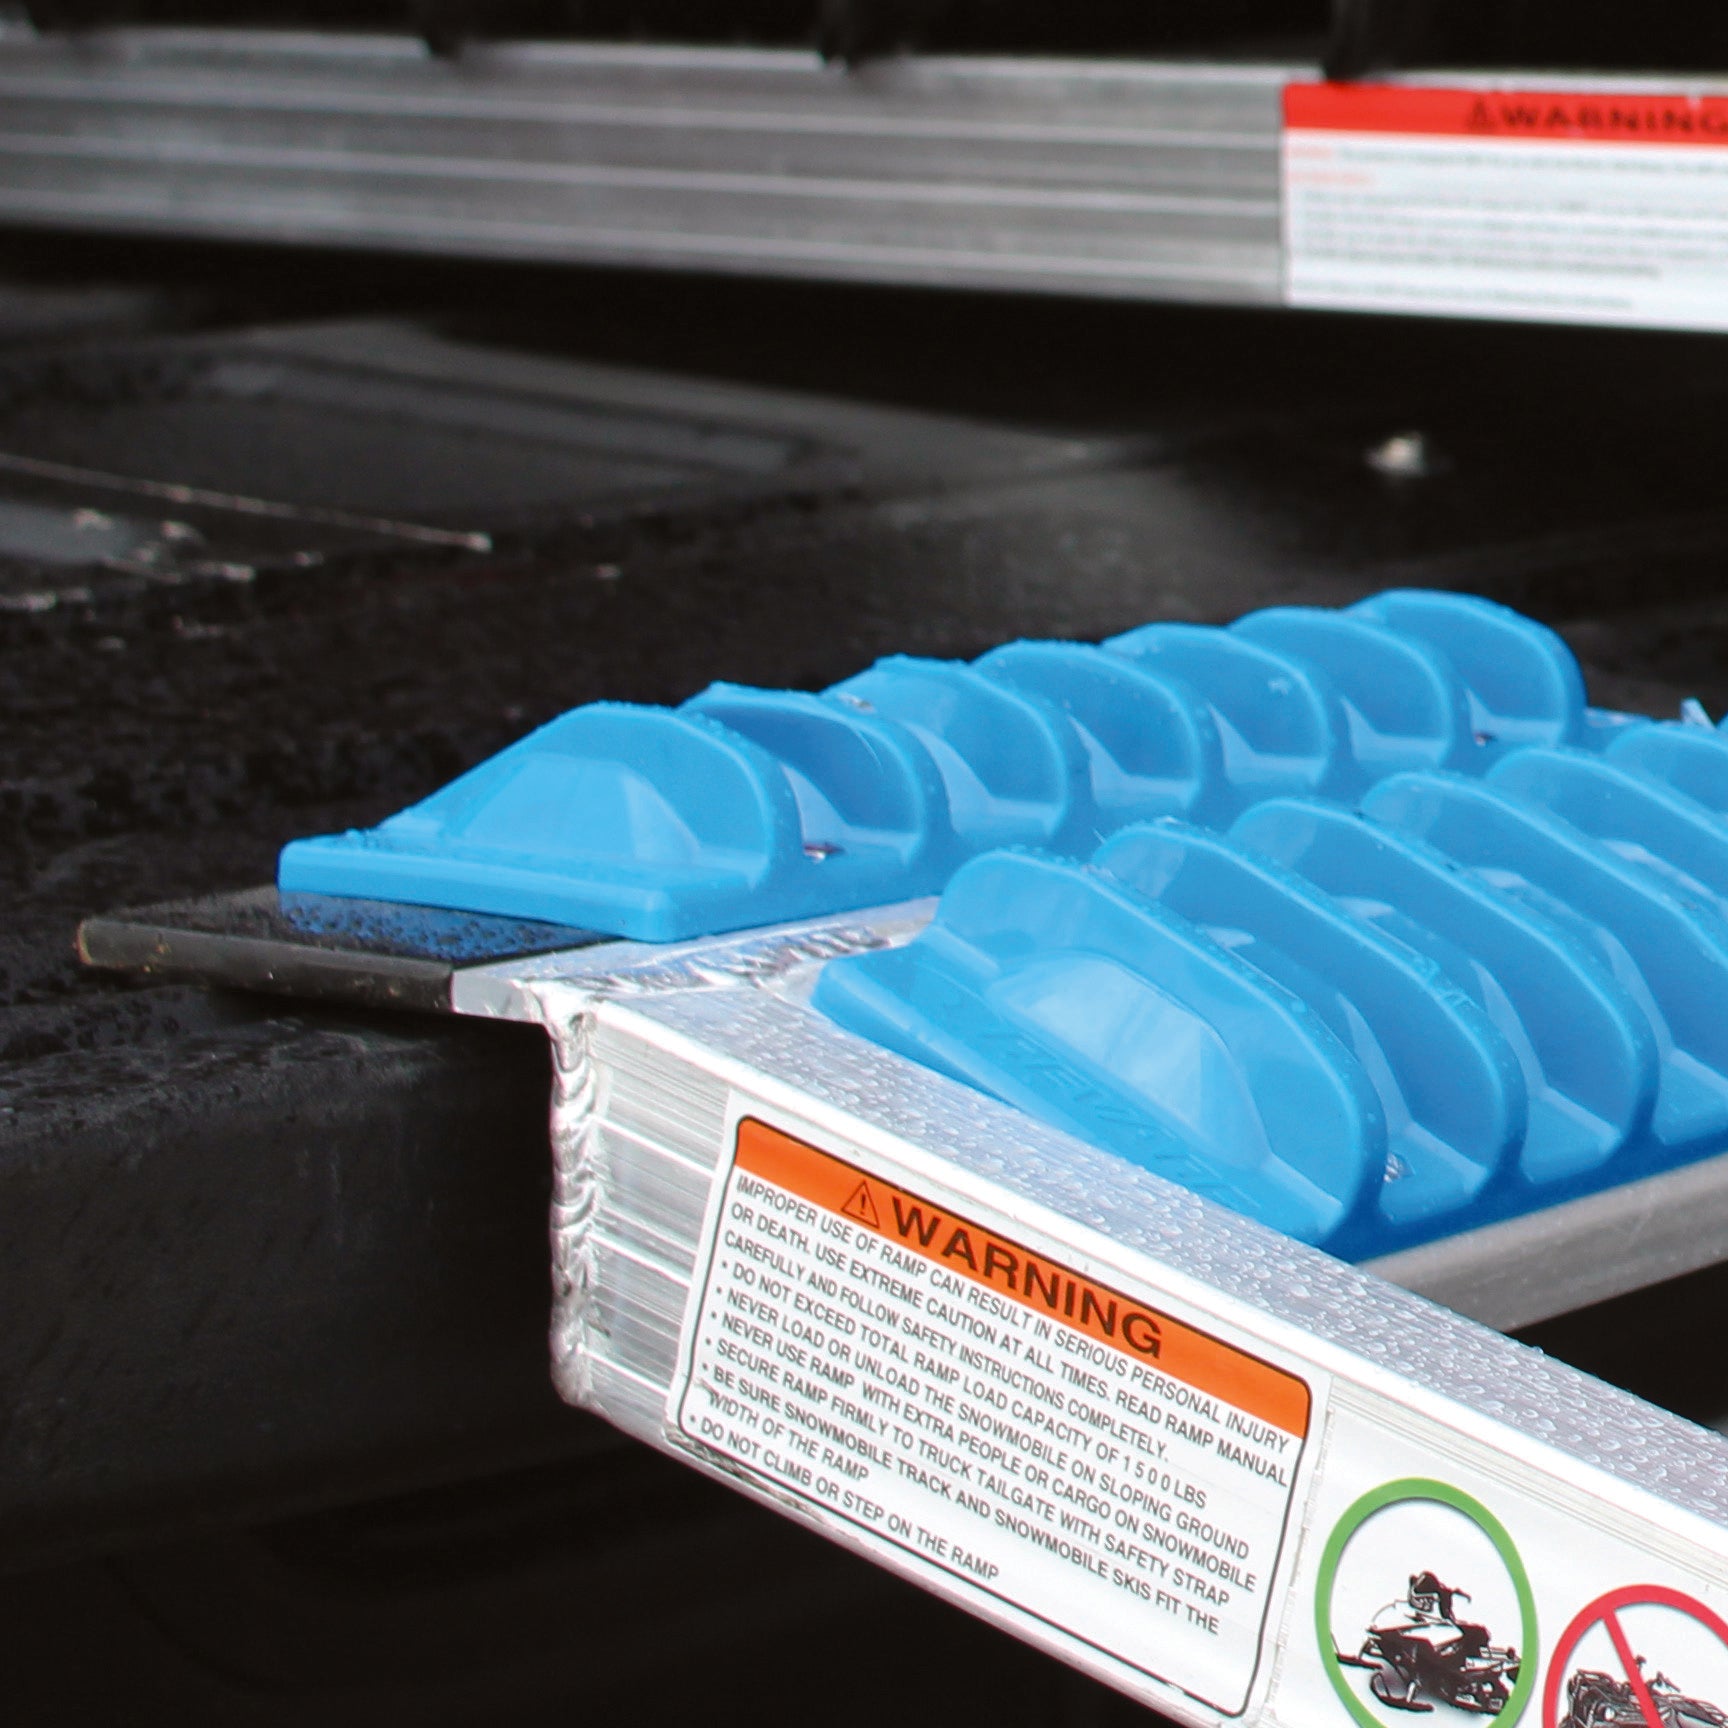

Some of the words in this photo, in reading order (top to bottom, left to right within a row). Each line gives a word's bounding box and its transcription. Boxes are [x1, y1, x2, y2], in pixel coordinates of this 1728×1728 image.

[724, 1229, 805, 1280] CAREFULLY
[807, 1271, 838, 1298] AND
[839, 1285, 900, 1328] FOLLOW
[901, 1316, 957, 1356] SAFETY
[958, 1344, 1065, 1411] INSTRUCTIONS
[731, 1202, 755, 1225] OR
[815, 1243, 847, 1272] USE
[849, 1259, 924, 1310] EXTREME
[926, 1297, 998, 1345] CAUTION
[999, 1333, 1023, 1356] AT
[1023, 1346, 1054, 1374] ALL
[1115, 1388, 1162, 1425] READ
[1164, 1412, 1215, 1448] RAMP
[1216, 1438, 1288, 1488] MANUAL
[732, 1261, 756, 1286] DO
[758, 1275, 792, 1302] NOT
[793, 1292, 857, 1336] EXCEED
[861, 1323, 909, 1364] TOTAL
[913, 1351, 961, 1384] RAMP
[962, 1376, 1008, 1411] LOAD
[1011, 1399, 1093, 1451] CAPACITY
[1095, 1441, 1120, 1463] OF
[1173, 1479, 1207, 1510] LBS
[736, 1175, 818, 1226] IMPROPER
[820, 1216, 853, 1244] USE
[855, 1232, 879, 1253] OF
[880, 1244, 928, 1277] RAMP
[929, 1268, 965, 1298] CAN
[967, 1286, 1033, 1329] RESULT
[1033, 1319, 1052, 1340] IN
[1054, 1328, 1128, 1377] SERIOUS
[1130, 1365, 1221, 1424] PERSONAL
[1225, 1411, 1289, 1453] INJURY
[892, 1196, 1162, 1359] WARNING
[700, 1416, 725, 1441] DO
[727, 1430, 761, 1459] NOT
[763, 1449, 813, 1487] CLIMB
[815, 1476, 840, 1501] OR
[842, 1489, 885, 1521] STEP
[887, 1513, 912, 1538] ON
[917, 1526, 948, 1557] THE
[951, 1545, 999, 1580] RAMP
[713, 1364, 735, 1389] BE
[738, 1377, 781, 1413] SURE
[784, 1401, 893, 1470] SNOWMOBILE
[897, 1457, 952, 1500] TRACK
[955, 1489, 991, 1519] AND
[994, 1508, 1109, 1579] SNOWMOBILE
[1112, 1567, 1152, 1601] SKIS
[1155, 1589, 1182, 1615] FIT
[1185, 1603, 1220, 1636] THE
[716, 1338, 780, 1383] SECURE
[782, 1370, 829, 1404] RAMP
[830, 1395, 889, 1436] FIRMLY
[893, 1425, 914, 1450] TO
[919, 1438, 973, 1480] TRUCK
[977, 1467, 1056, 1522] TAILGATE
[1060, 1510, 1101, 1545] WITH
[1104, 1533, 1170, 1578] SAFETY
[1172, 1567, 1230, 1606] STRAP
[722, 1312, 774, 1350] NEVER
[776, 1339, 808, 1368] USE
[809, 1355, 856, 1389] RAMP
[862, 1381, 901, 1414] WITH
[902, 1402, 954, 1442] EXTRA
[958, 1430, 1022, 1476] PEOPLE
[1024, 1463, 1050, 1489] OR
[1051, 1477, 1112, 1520] CARGO
[1114, 1508, 1140, 1534] ON
[1142, 1522, 1257, 1593] SNOWMOBILE
[727, 1288, 780, 1326] NEVER
[781, 1315, 825, 1349] LOAD
[827, 1338, 852, 1363] OR
[854, 1351, 921, 1397] UNLOAD
[925, 1384, 955, 1415] THE
[957, 1402, 1068, 1471] SNOWMOBILE
[1071, 1459, 1096, 1485] ON
[1098, 1472, 1172, 1523] SLOPING
[1175, 1511, 1250, 1560] GROUND
[761, 1417, 785, 1437] OF
[789, 1429, 820, 1459] THE
[822, 1447, 870, 1479] RAMP
